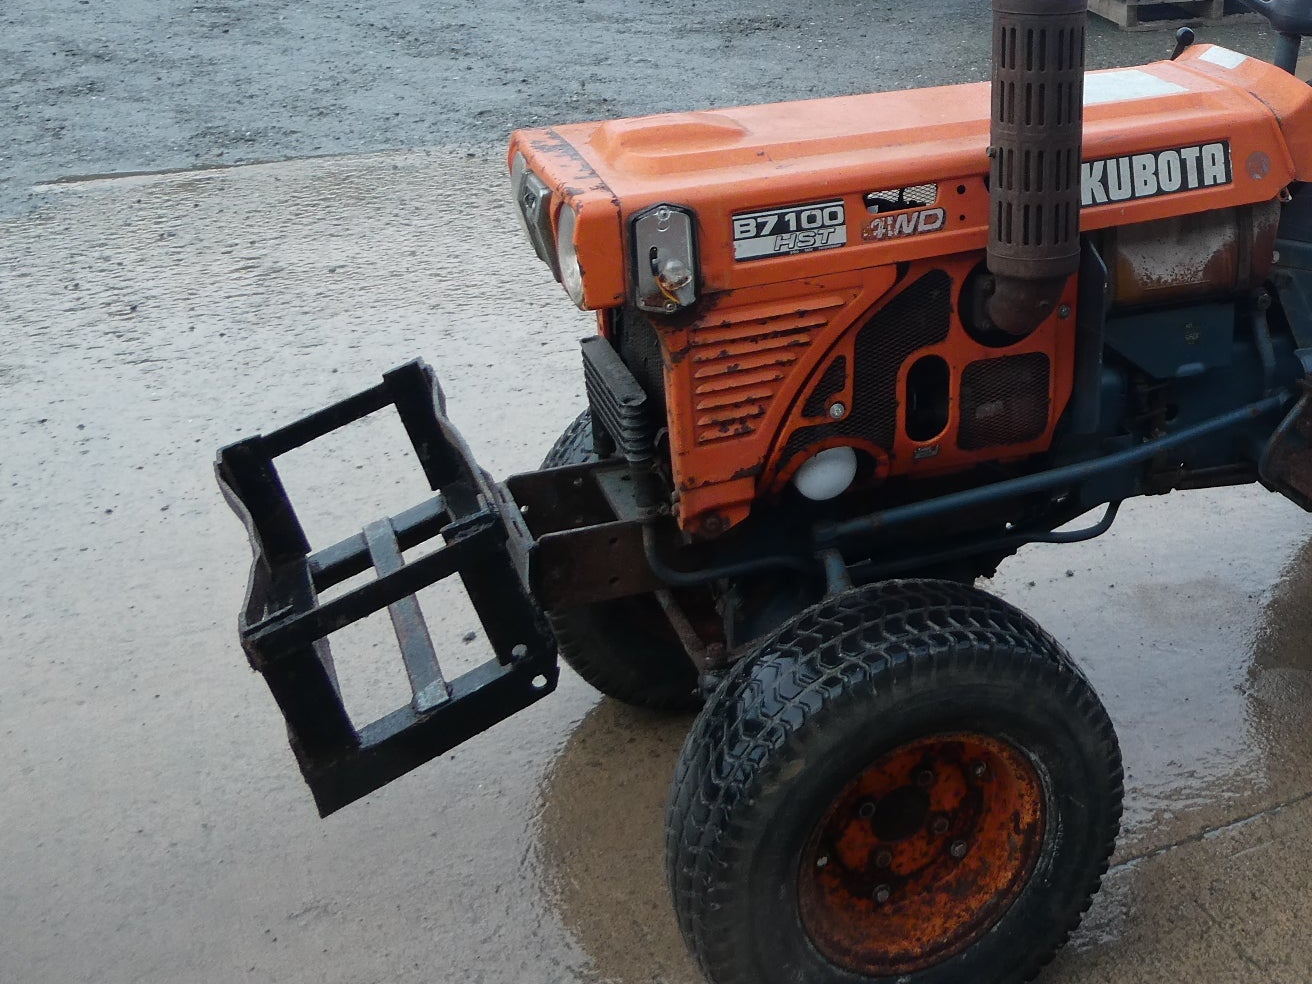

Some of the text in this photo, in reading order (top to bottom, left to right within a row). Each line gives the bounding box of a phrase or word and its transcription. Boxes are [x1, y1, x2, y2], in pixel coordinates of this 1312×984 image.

[1080, 142, 1226, 206] KUBOTA
[733, 206, 845, 239] B7100
[773, 228, 836, 252] HST
